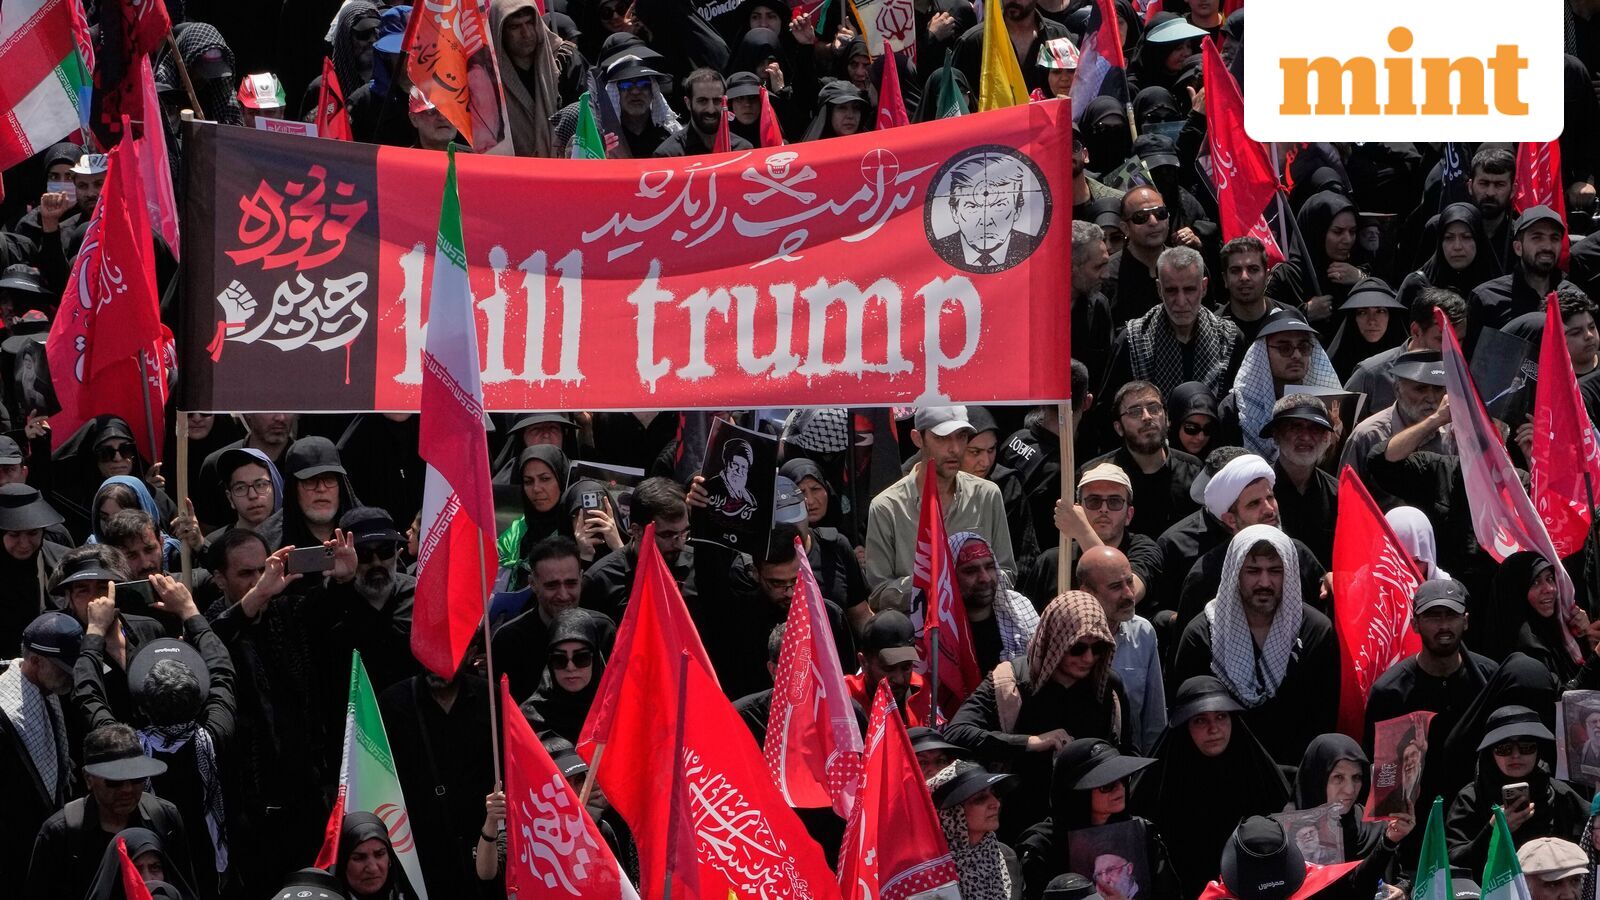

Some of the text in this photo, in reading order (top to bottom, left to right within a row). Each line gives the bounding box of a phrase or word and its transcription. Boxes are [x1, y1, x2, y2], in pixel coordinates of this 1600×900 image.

[581, 151, 939, 269] ترامپ را بکشید
[393, 241, 983, 404] kill trump
